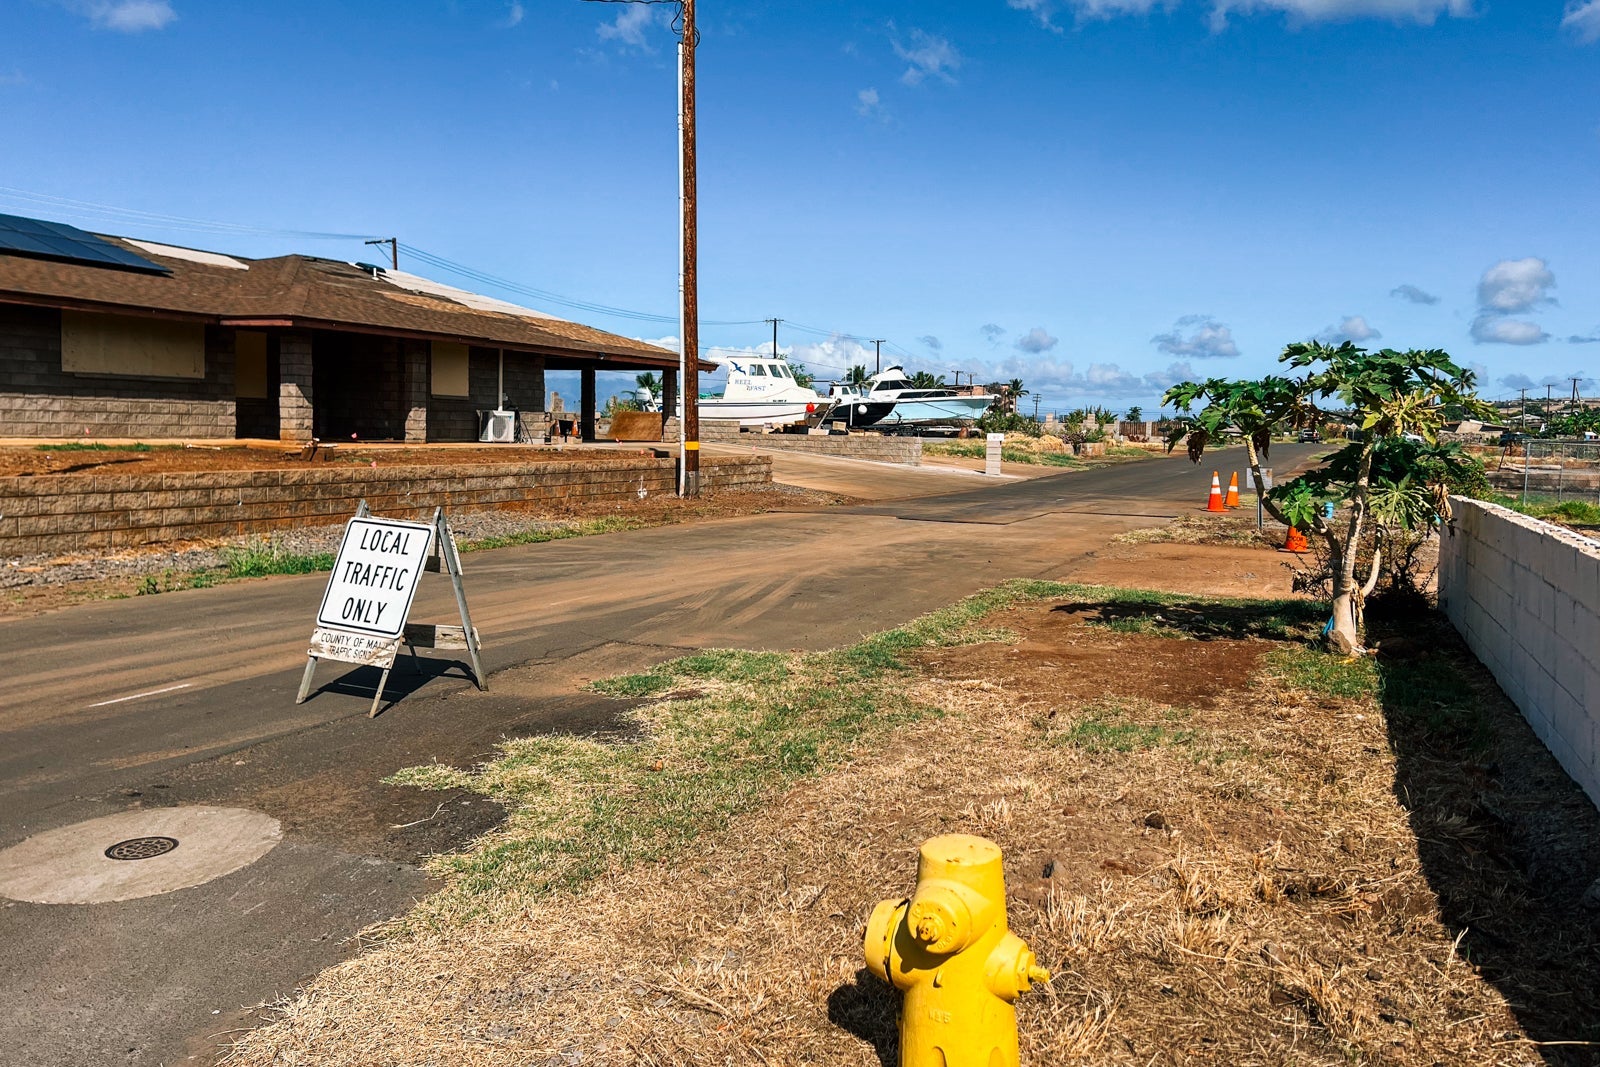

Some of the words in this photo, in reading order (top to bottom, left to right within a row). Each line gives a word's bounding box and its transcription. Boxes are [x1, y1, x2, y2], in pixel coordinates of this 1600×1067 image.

[360, 528, 410, 556] LOCAL
[343, 561, 409, 591] TRAFFIC
[342, 597, 388, 625] ONLY
[321, 632, 352, 646] COUNTY
[353, 637, 365, 647] OF
